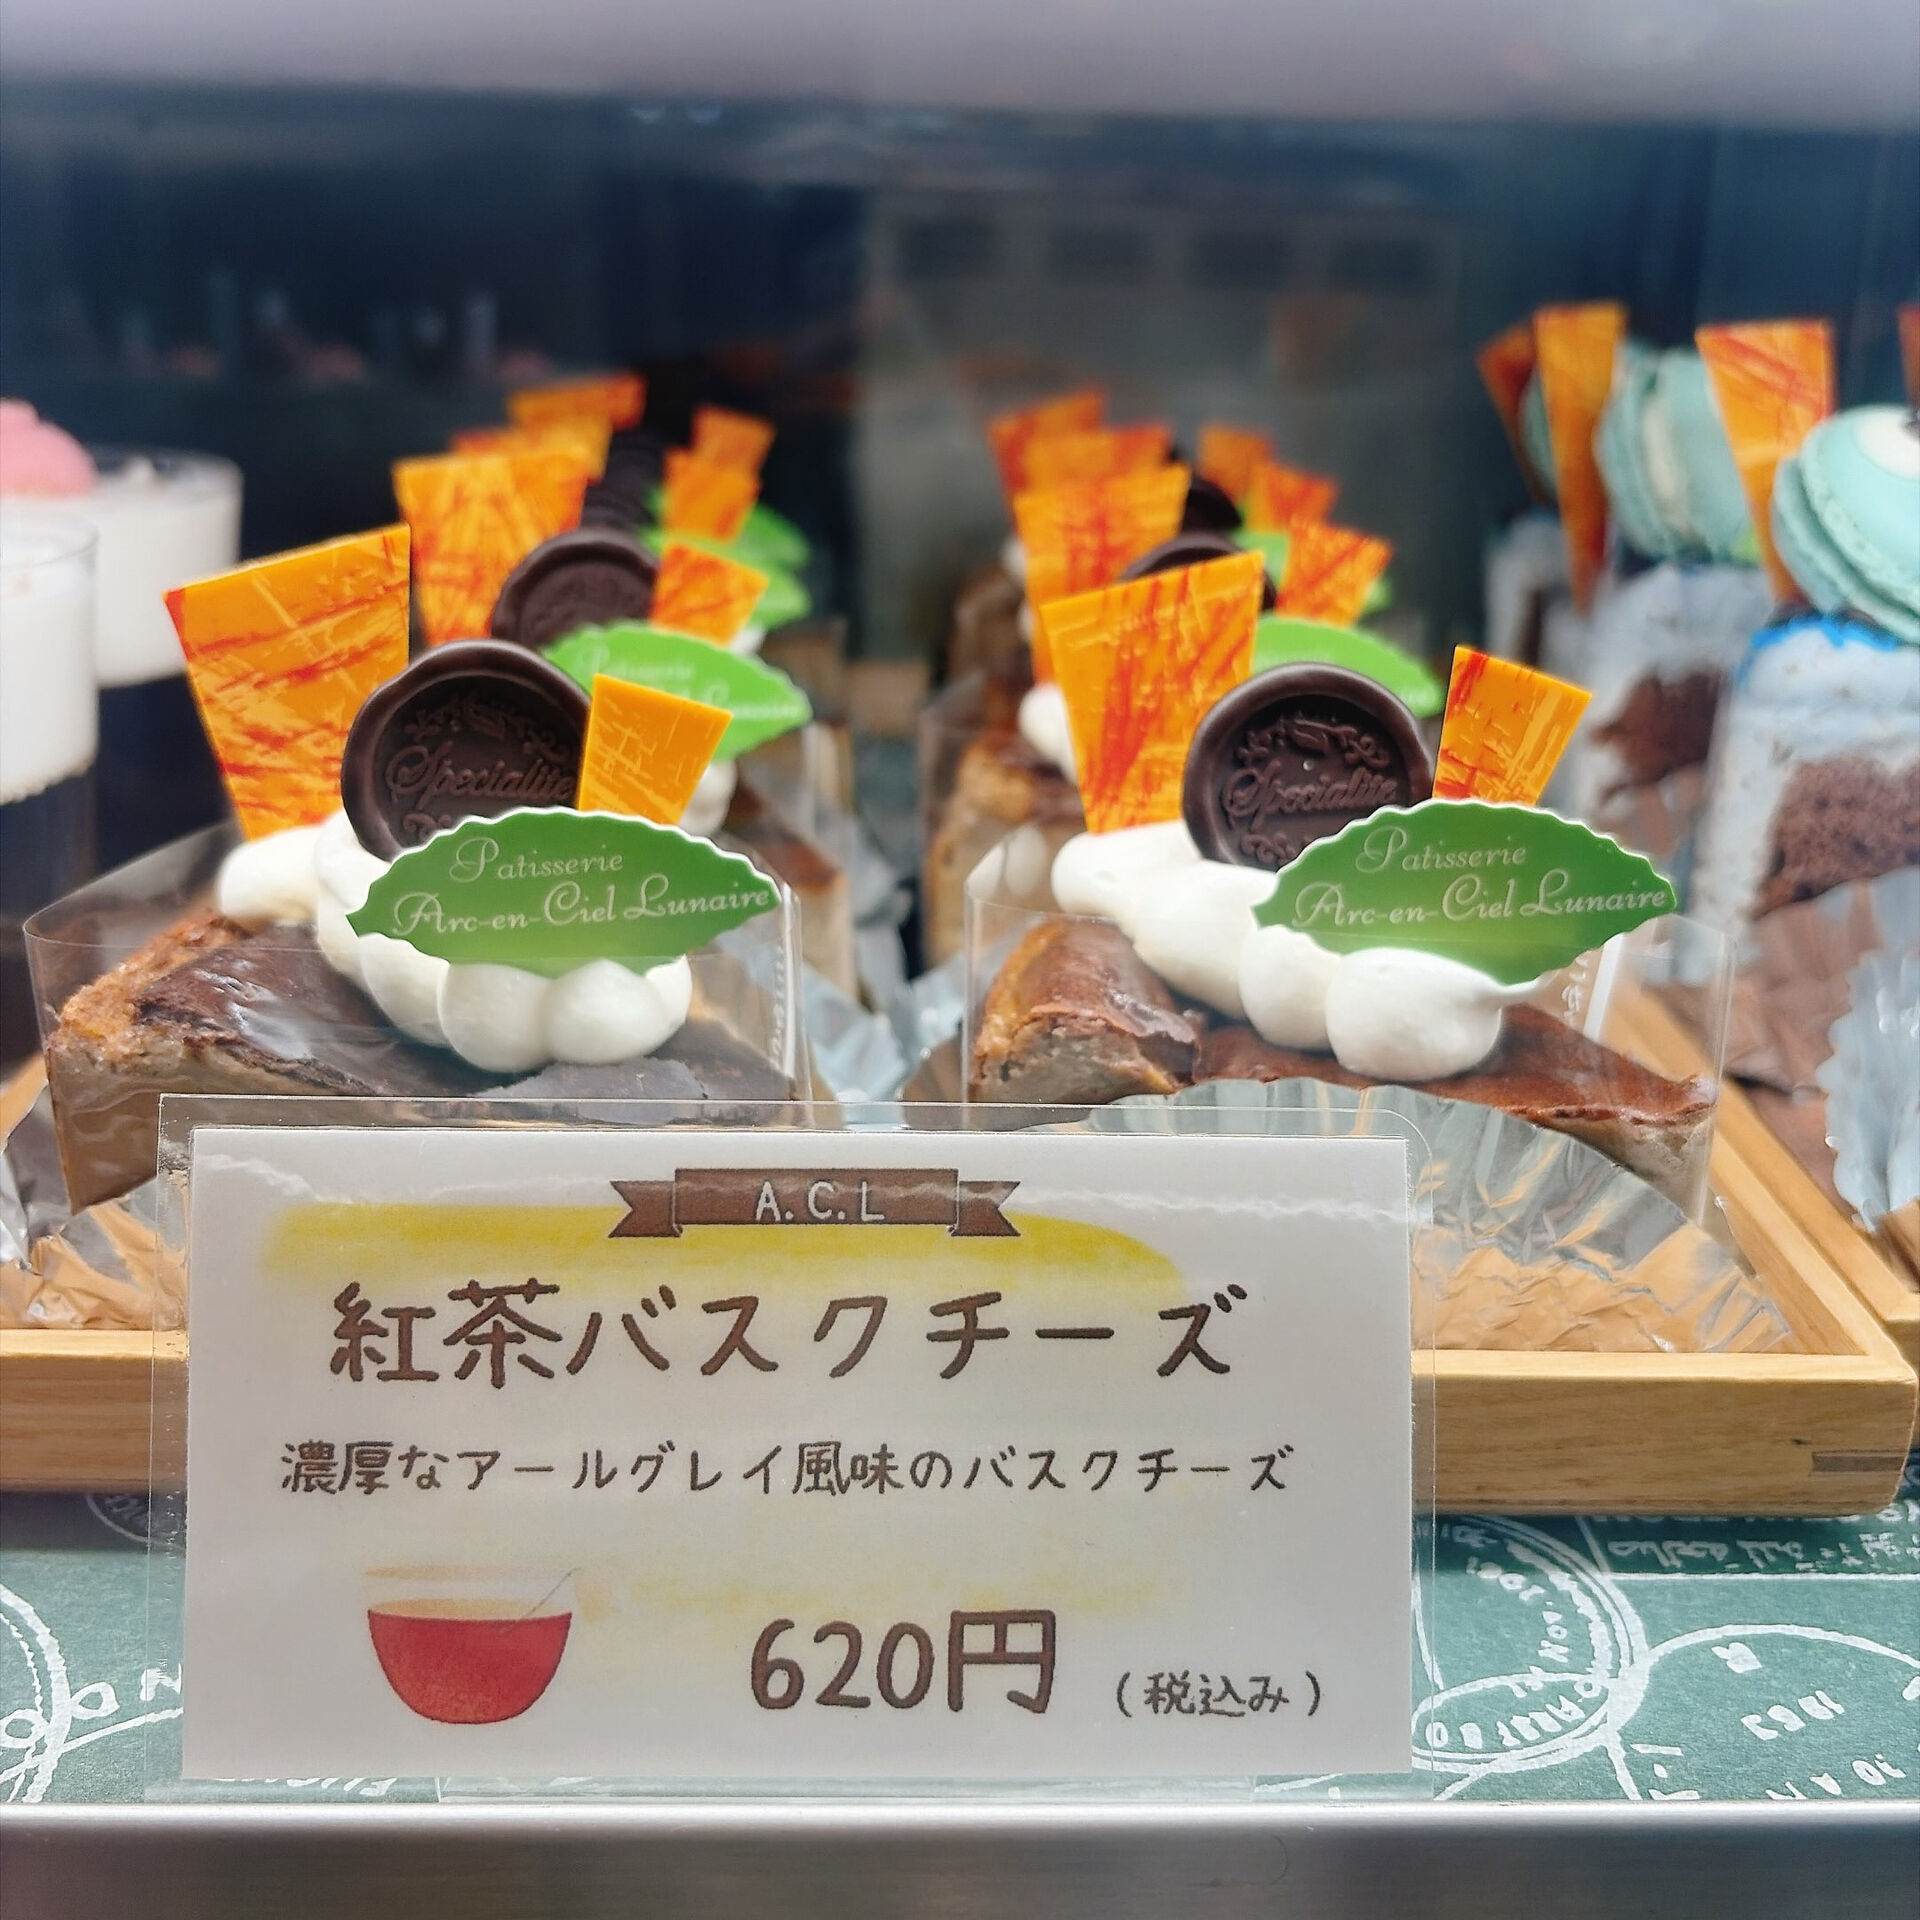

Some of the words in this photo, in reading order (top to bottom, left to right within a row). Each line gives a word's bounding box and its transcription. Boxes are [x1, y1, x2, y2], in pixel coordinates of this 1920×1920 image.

[450, 837, 623, 882] Patisserie
[1356, 826, 1526, 872] Patisserie
[392, 881, 615, 936] Arc-en-Ciel
[623, 873, 770, 919] Lunaire
[1292, 874, 1514, 927] Arc-en-Ciel
[1520, 869, 1666, 915] Lunaire
[755, 1180, 885, 1223] A.C.L
[330, 1278, 1248, 1389] 紅茶バスクチーズ
[281, 1439, 1295, 1497] 濃厚なアールグレイ風味のバスクチーズ
[750, 1609, 1057, 1714] 620円
[1116, 1669, 1322, 1718] (税込み)
